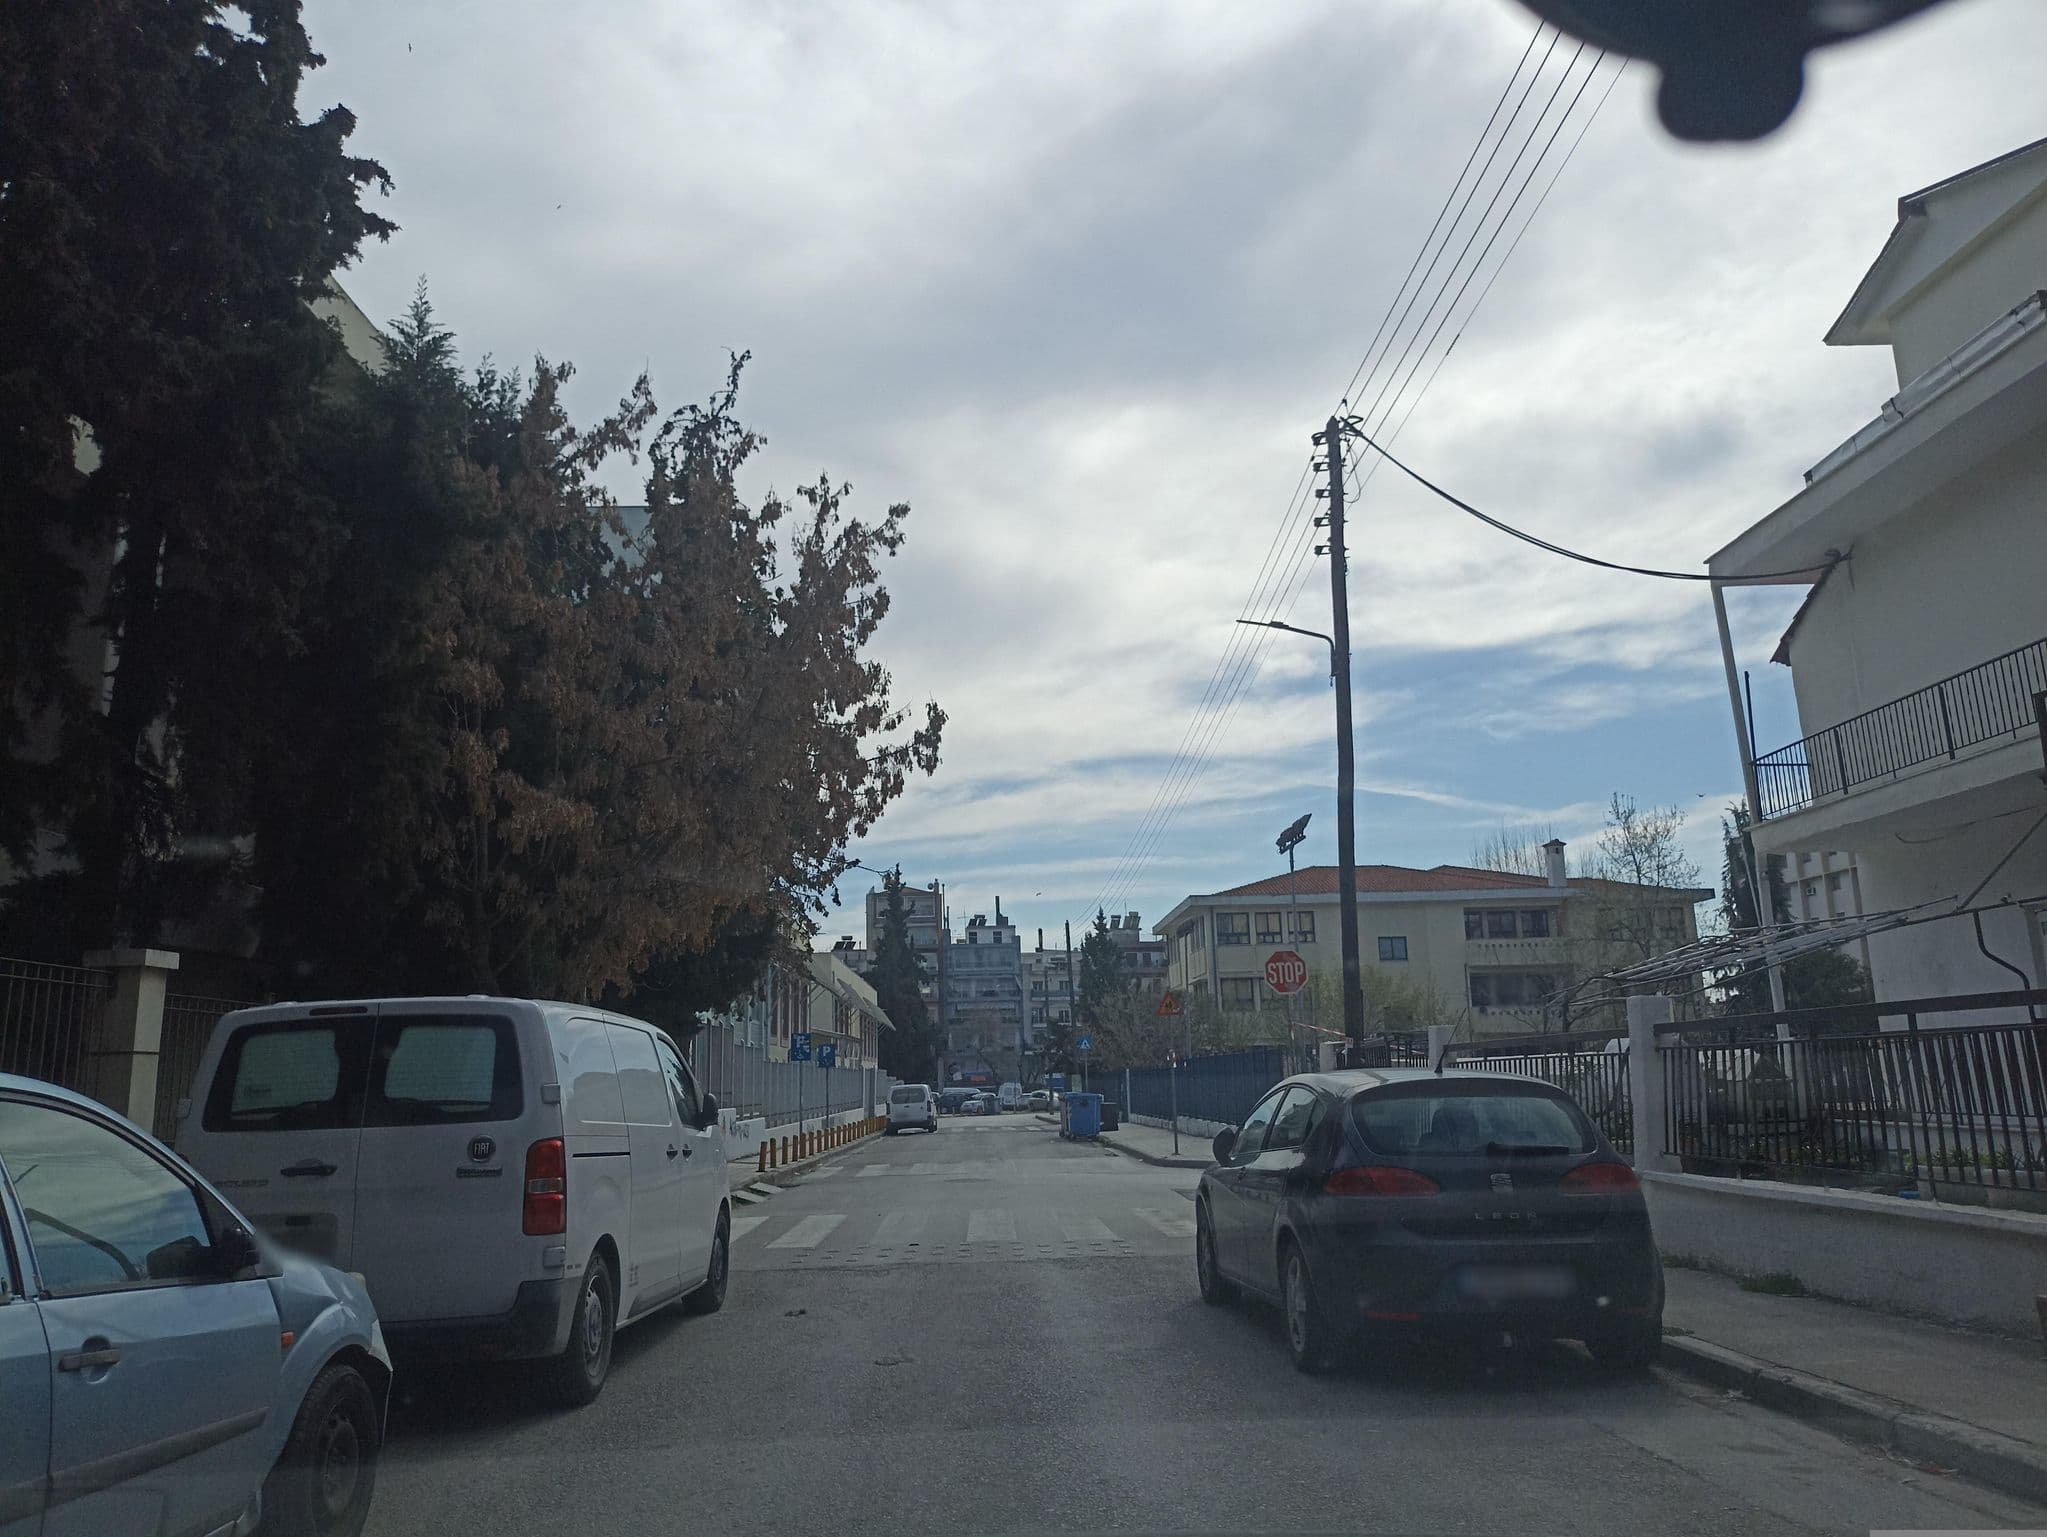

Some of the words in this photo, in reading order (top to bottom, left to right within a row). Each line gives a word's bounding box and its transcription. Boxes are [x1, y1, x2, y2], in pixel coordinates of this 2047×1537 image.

[1267, 961, 1304, 984] STOP
[822, 1046, 831, 1057] P
[474, 1142, 490, 1155] FIAT
